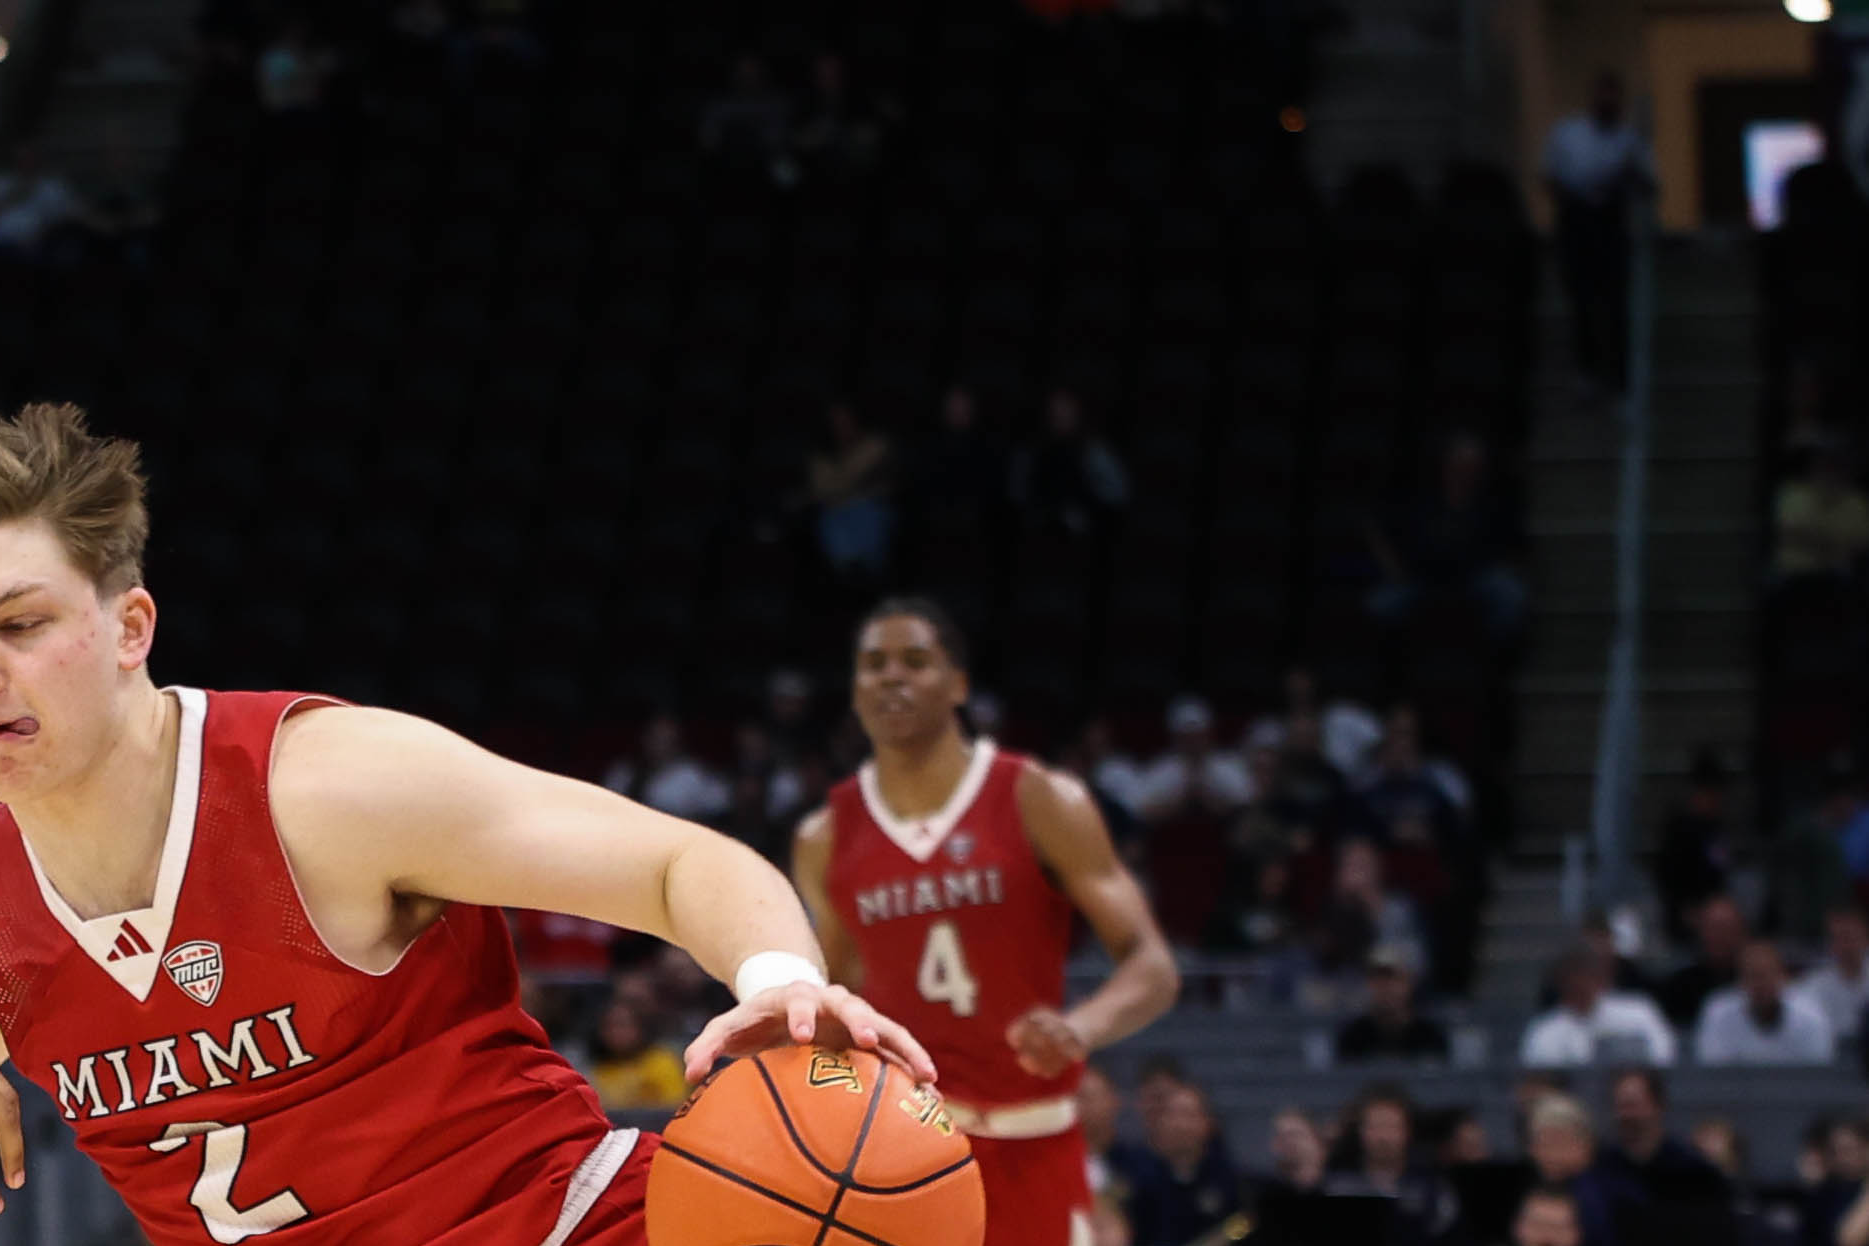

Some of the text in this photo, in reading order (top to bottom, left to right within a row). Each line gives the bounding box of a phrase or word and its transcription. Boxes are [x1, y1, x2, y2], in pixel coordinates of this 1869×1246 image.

[855, 867, 1004, 926] MIAMI
[173, 958, 221, 984] MAC
[916, 920, 977, 1017] 4
[51, 1004, 317, 1120] MIAMI
[148, 1120, 311, 1245] 2
